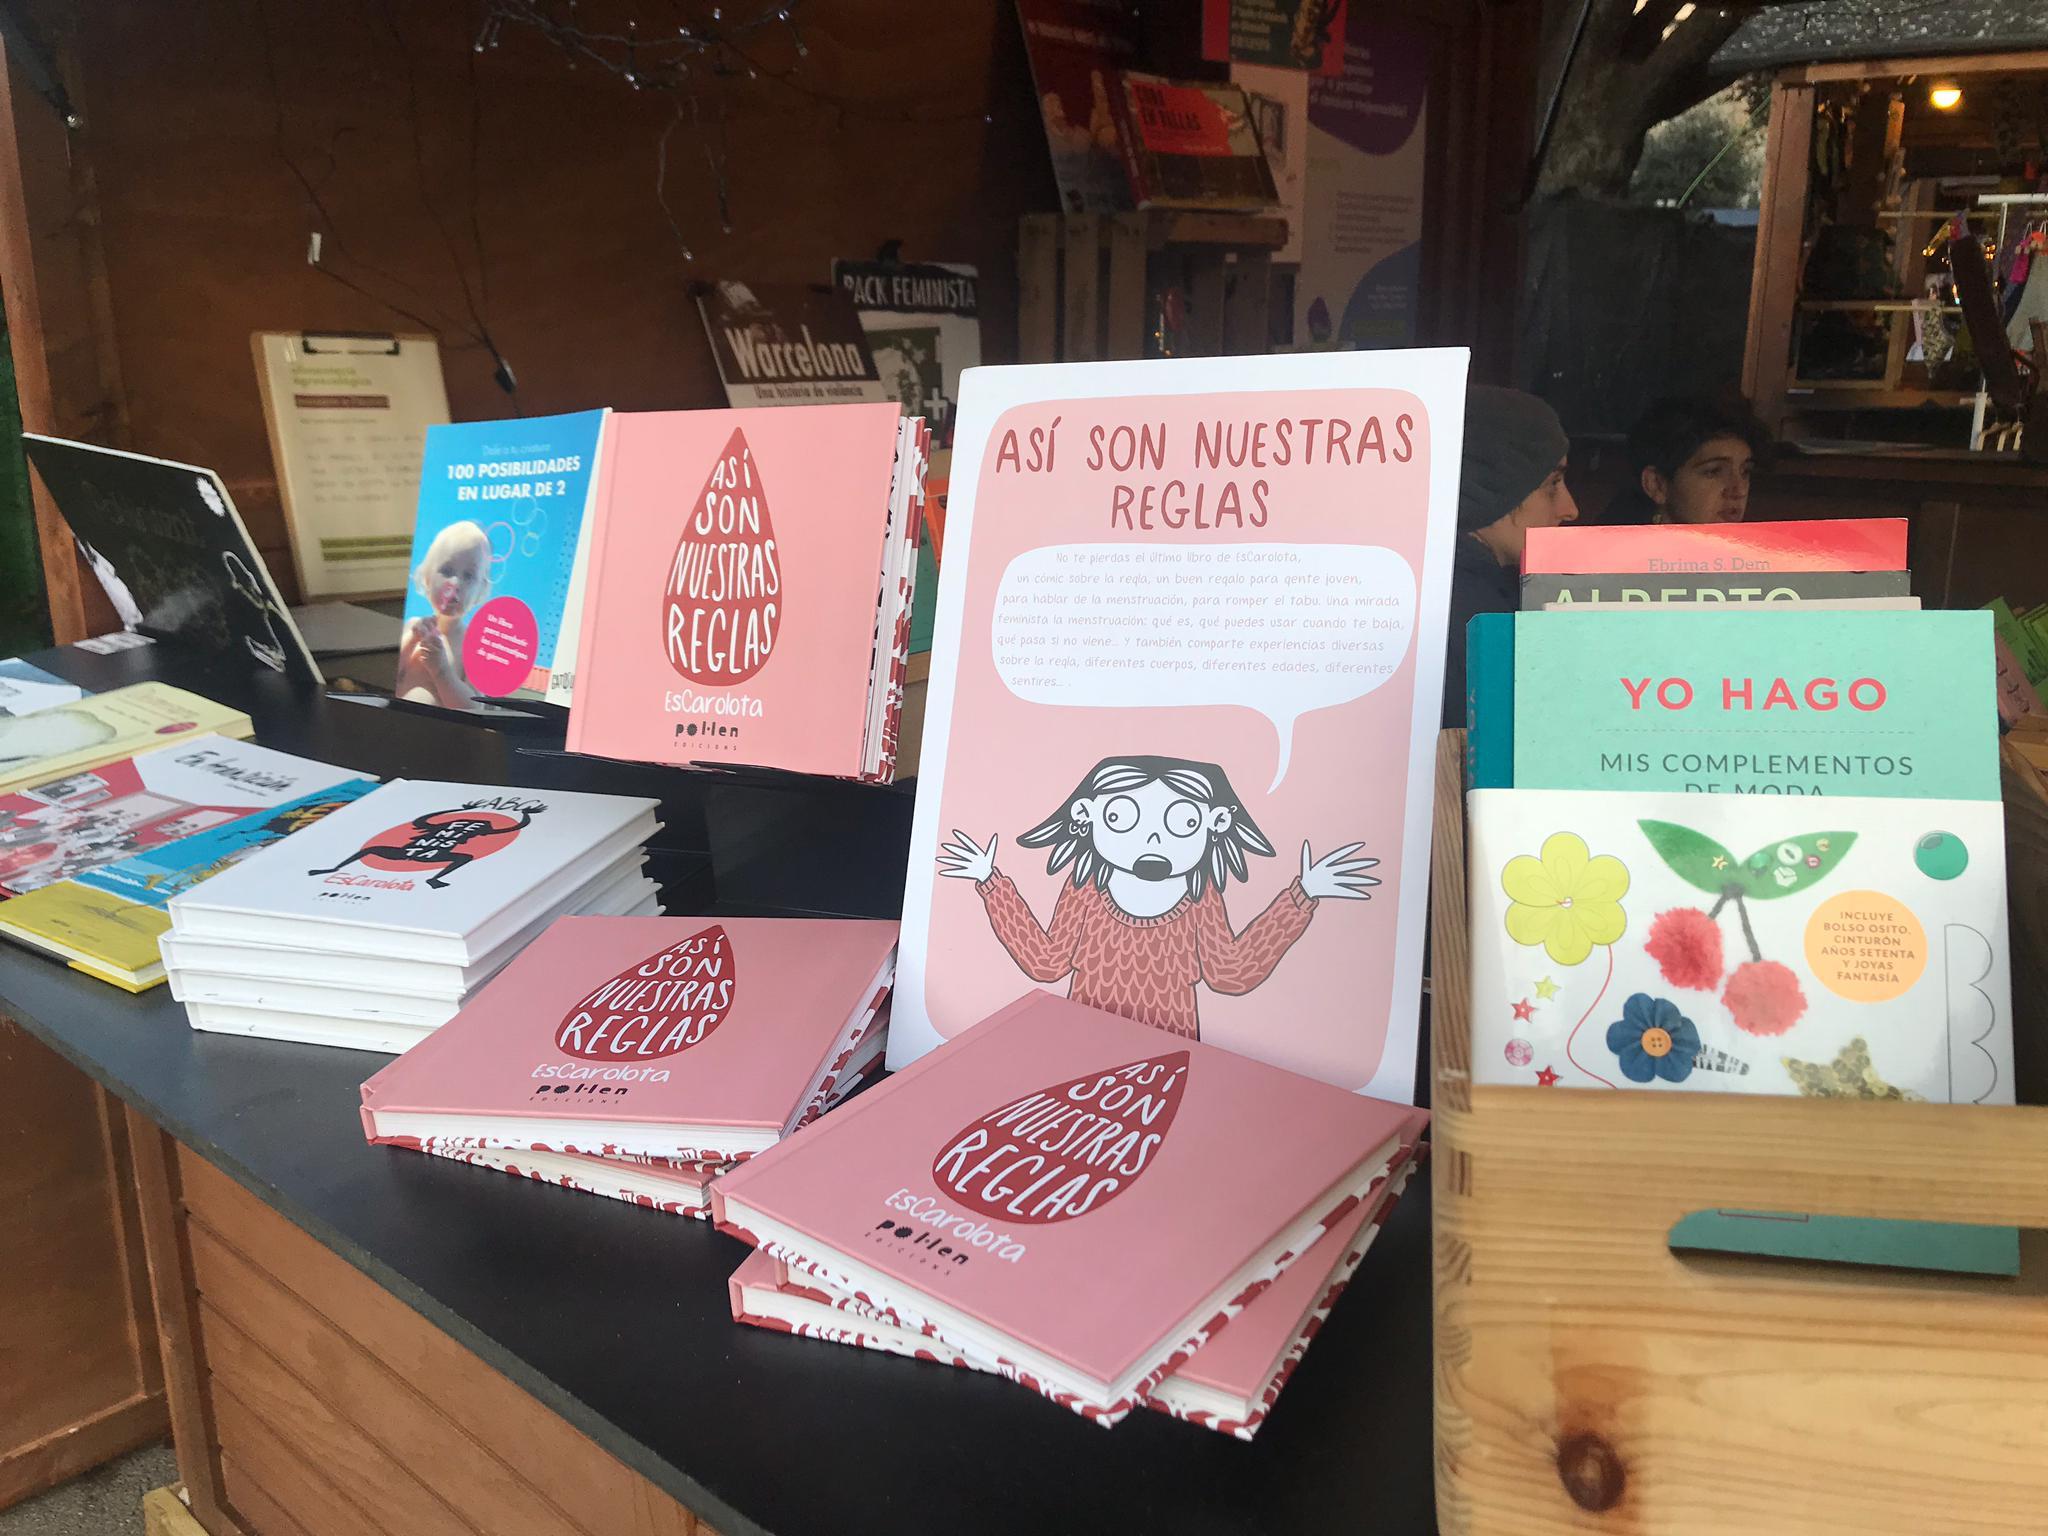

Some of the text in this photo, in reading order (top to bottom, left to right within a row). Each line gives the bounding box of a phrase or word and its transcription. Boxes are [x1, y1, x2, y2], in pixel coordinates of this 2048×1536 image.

[843, 273, 976, 306] PACK FEMINISTA
[724, 324, 866, 378] Warcelona
[996, 413, 1413, 473] ASÍ SON NUESTRAS
[447, 456, 580, 479] 100 POSIBILIDADES
[458, 480, 565, 500] EN LUGAR DE 2
[695, 491, 760, 535] SON
[1111, 479, 1270, 531] REGLAS
[1056, 552, 1069, 563] No
[1073, 553, 1085, 563] te
[1089, 552, 1130, 565] pierdas
[1135, 553, 1145, 563] el
[1149, 552, 1181, 563] último
[1187, 552, 1212, 563] libro
[1217, 551, 1231, 562] de
[1648, 557, 1770, 573] Ebrima S. Dem
[666, 539, 779, 602] NUESTRAS
[1017, 572, 1362, 587] un cómic sobre la regla, un buen regalo para gente joven,
[1002, 594, 1028, 606] para
[1033, 593, 1069, 604] hablar
[1073, 594, 1087, 604] de
[1091, 594, 1101, 604] la
[1106, 594, 1188, 606] menstruación,
[1192, 596, 1220, 608] para
[1226, 595, 1268, 608] romper
[1274, 595, 1284, 606] el
[1327, 596, 1349, 607] Una
[1355, 595, 1399, 607] mirada
[998, 613, 1404, 632] feminista la menstruación: qué es, qué puedes usar cuando te baja,
[667, 602, 776, 674] REGLAS
[997, 634, 1016, 646] qué
[1020, 636, 1046, 648] pasa
[1051, 636, 1060, 645] si
[1064, 637, 1078, 646] no
[1135, 636, 1181, 648] también
[1187, 639, 1245, 650] comparte
[1250, 640, 1326, 652] experiencias
[1331, 640, 1384, 652] diversas
[999, 655, 1394, 674] sobre la regla, diferentes cuerpos, diferentes edades, diferentes
[664, 688, 763, 718] EsCarolota
[1620, 677, 1887, 711] YO HAGO
[1601, 752, 1913, 776] MIS COMPLEMENTOS
[405, 848, 440, 859] TA
[323, 873, 416, 892] EsCarolota
[1823, 922, 1865, 932] BOLSO
[1840, 911, 1894, 921] INCLUYE
[1834, 935, 1901, 946] CINTURÓN
[1821, 945, 1915, 960] AÑOS SETENTA
[637, 954, 722, 978] SON
[1842, 960, 1894, 970] Y JOYAS
[1837, 971, 1900, 983] FANTASÍA
[579, 978, 733, 1013] NUESTRAS
[559, 1011, 718, 1055] REGLAS
[531, 1062, 671, 1083] EsCarolota
[1067, 1075, 1167, 1126] SON
[983, 1093, 1162, 1176] NUESTRAS
[935, 1128, 1119, 1219] REGLAS
[884, 1187, 1027, 1264] EsCarolota
